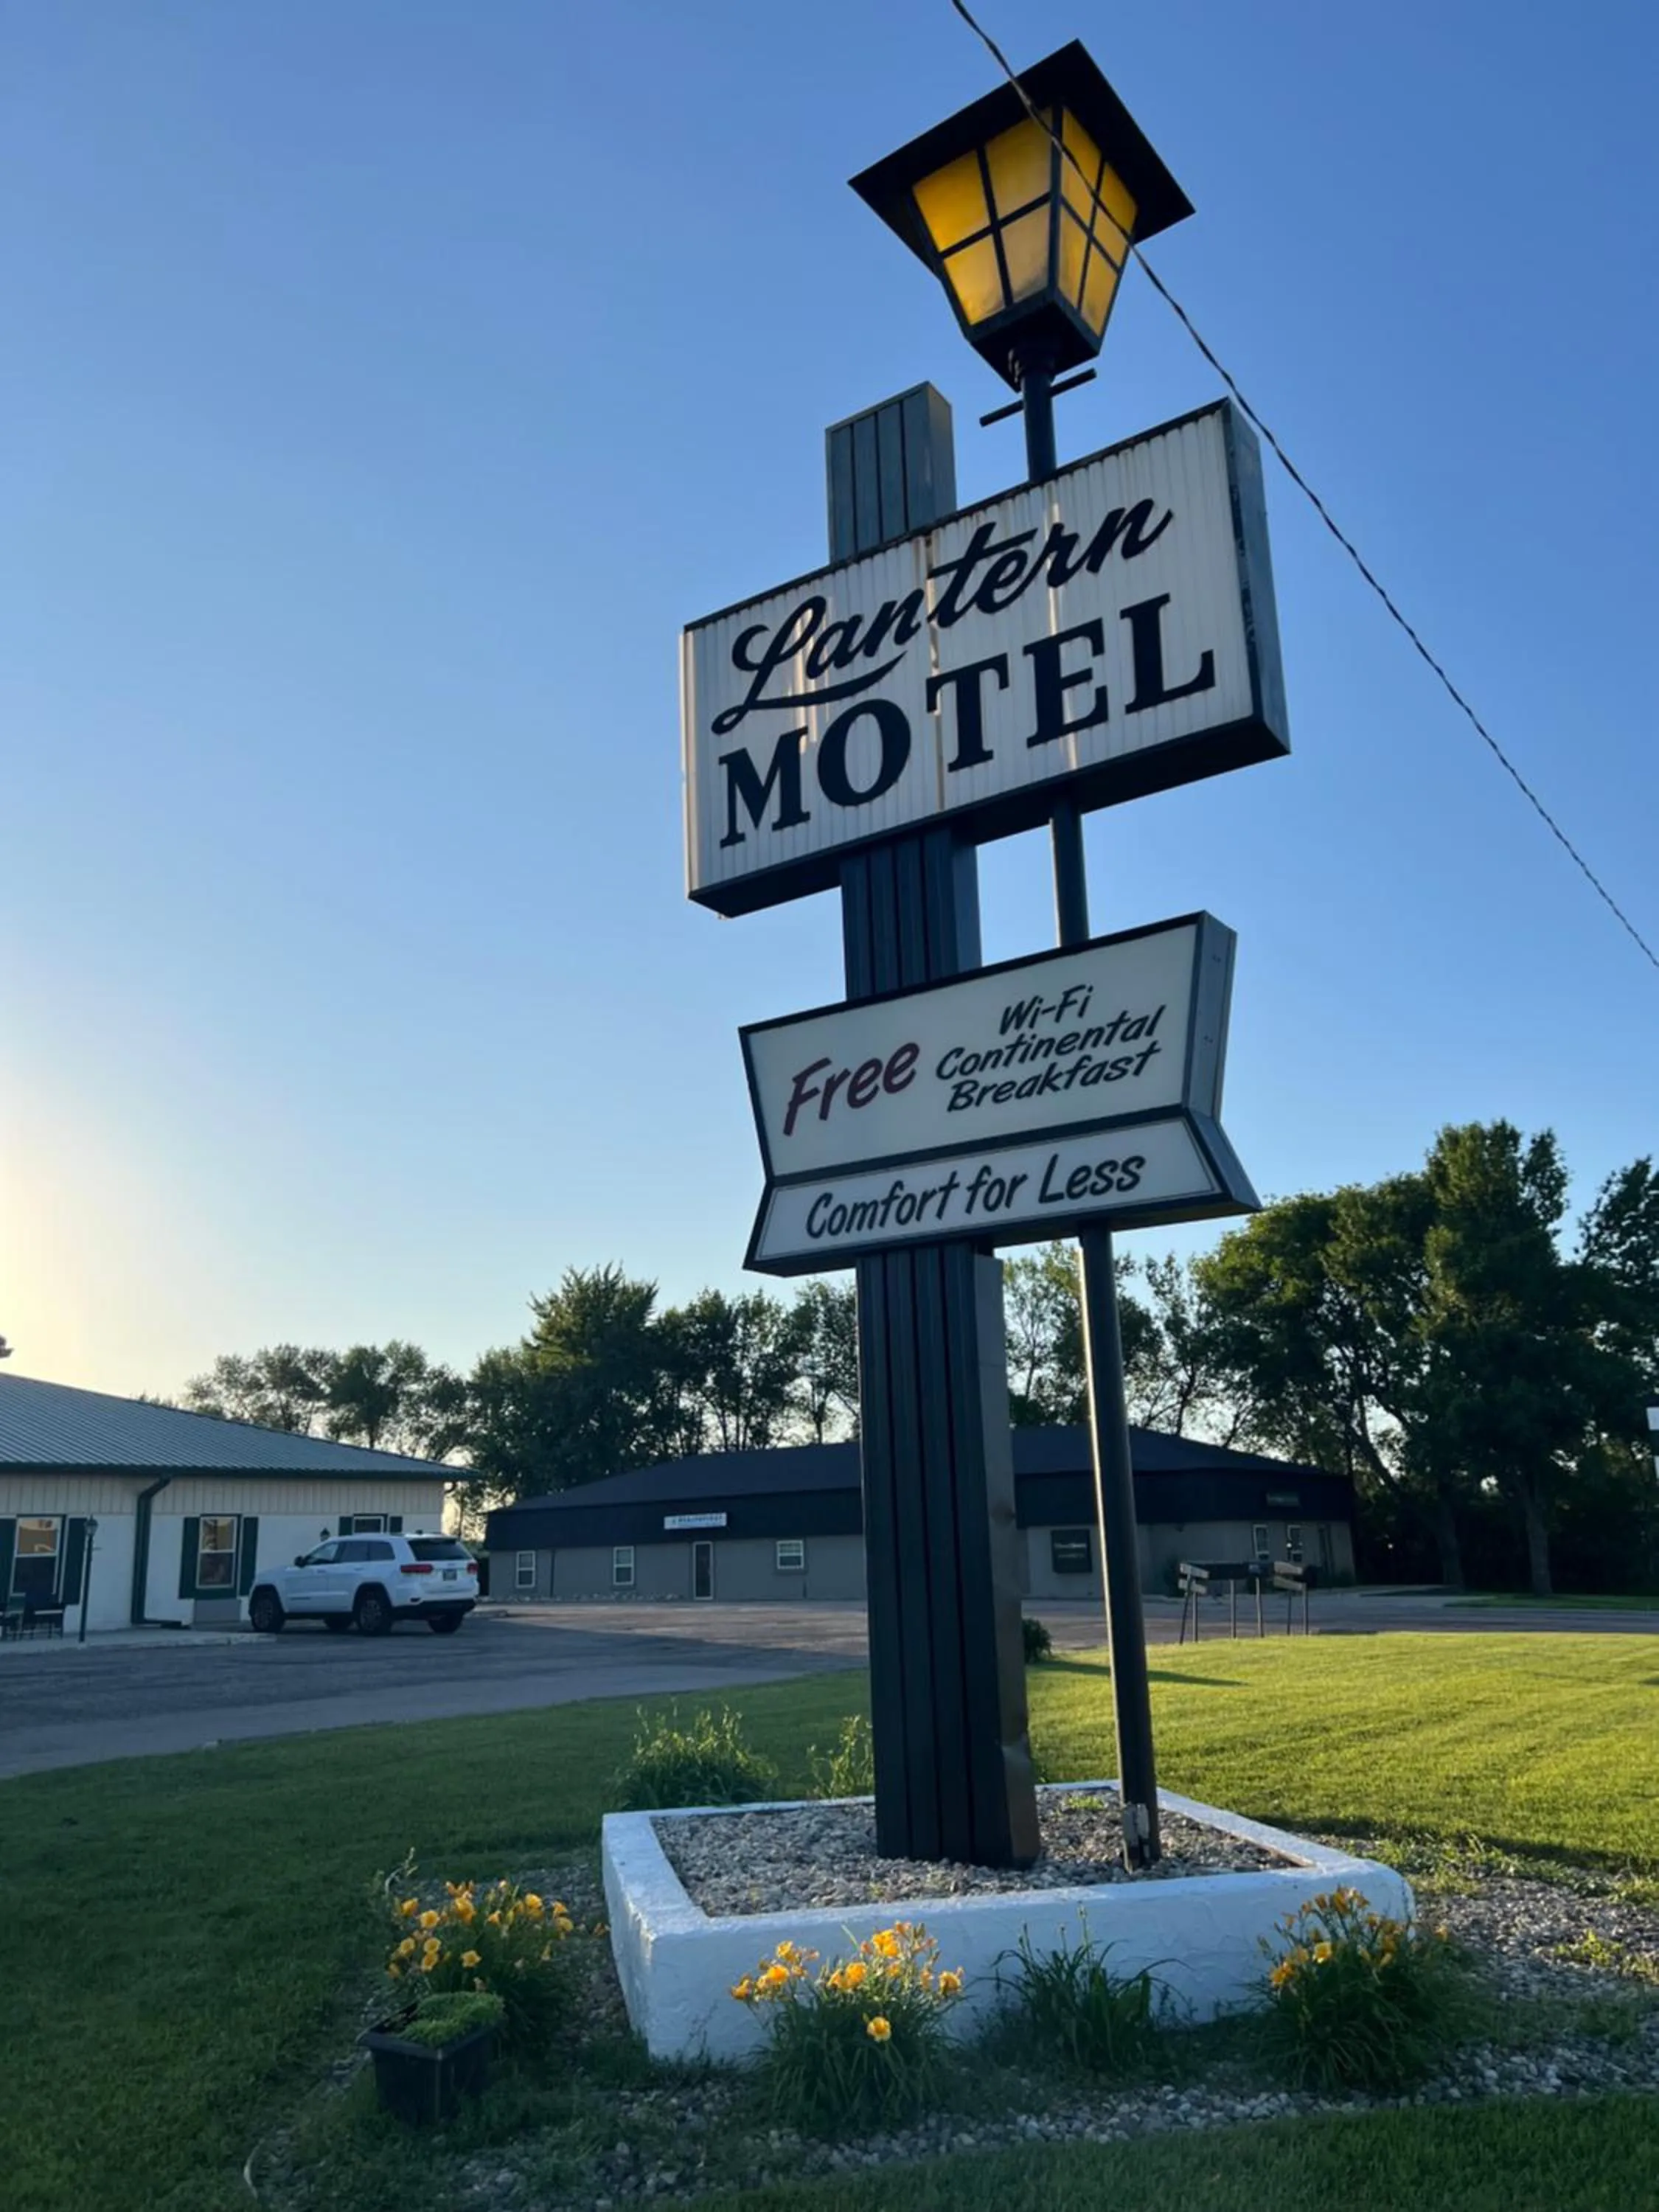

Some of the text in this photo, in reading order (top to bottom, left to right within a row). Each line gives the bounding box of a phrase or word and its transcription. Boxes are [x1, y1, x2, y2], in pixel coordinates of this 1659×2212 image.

[711, 498, 1173, 735] Lantern
[719, 593, 1215, 848] MOTEL
[936, 1005, 1166, 1080] Continental
[999, 984, 1093, 1035] Wi-Fi
[783, 1043, 919, 1136] Free
[947, 1043, 1161, 1112] Breakfast
[807, 1154, 1145, 1239] Comfort for Less
